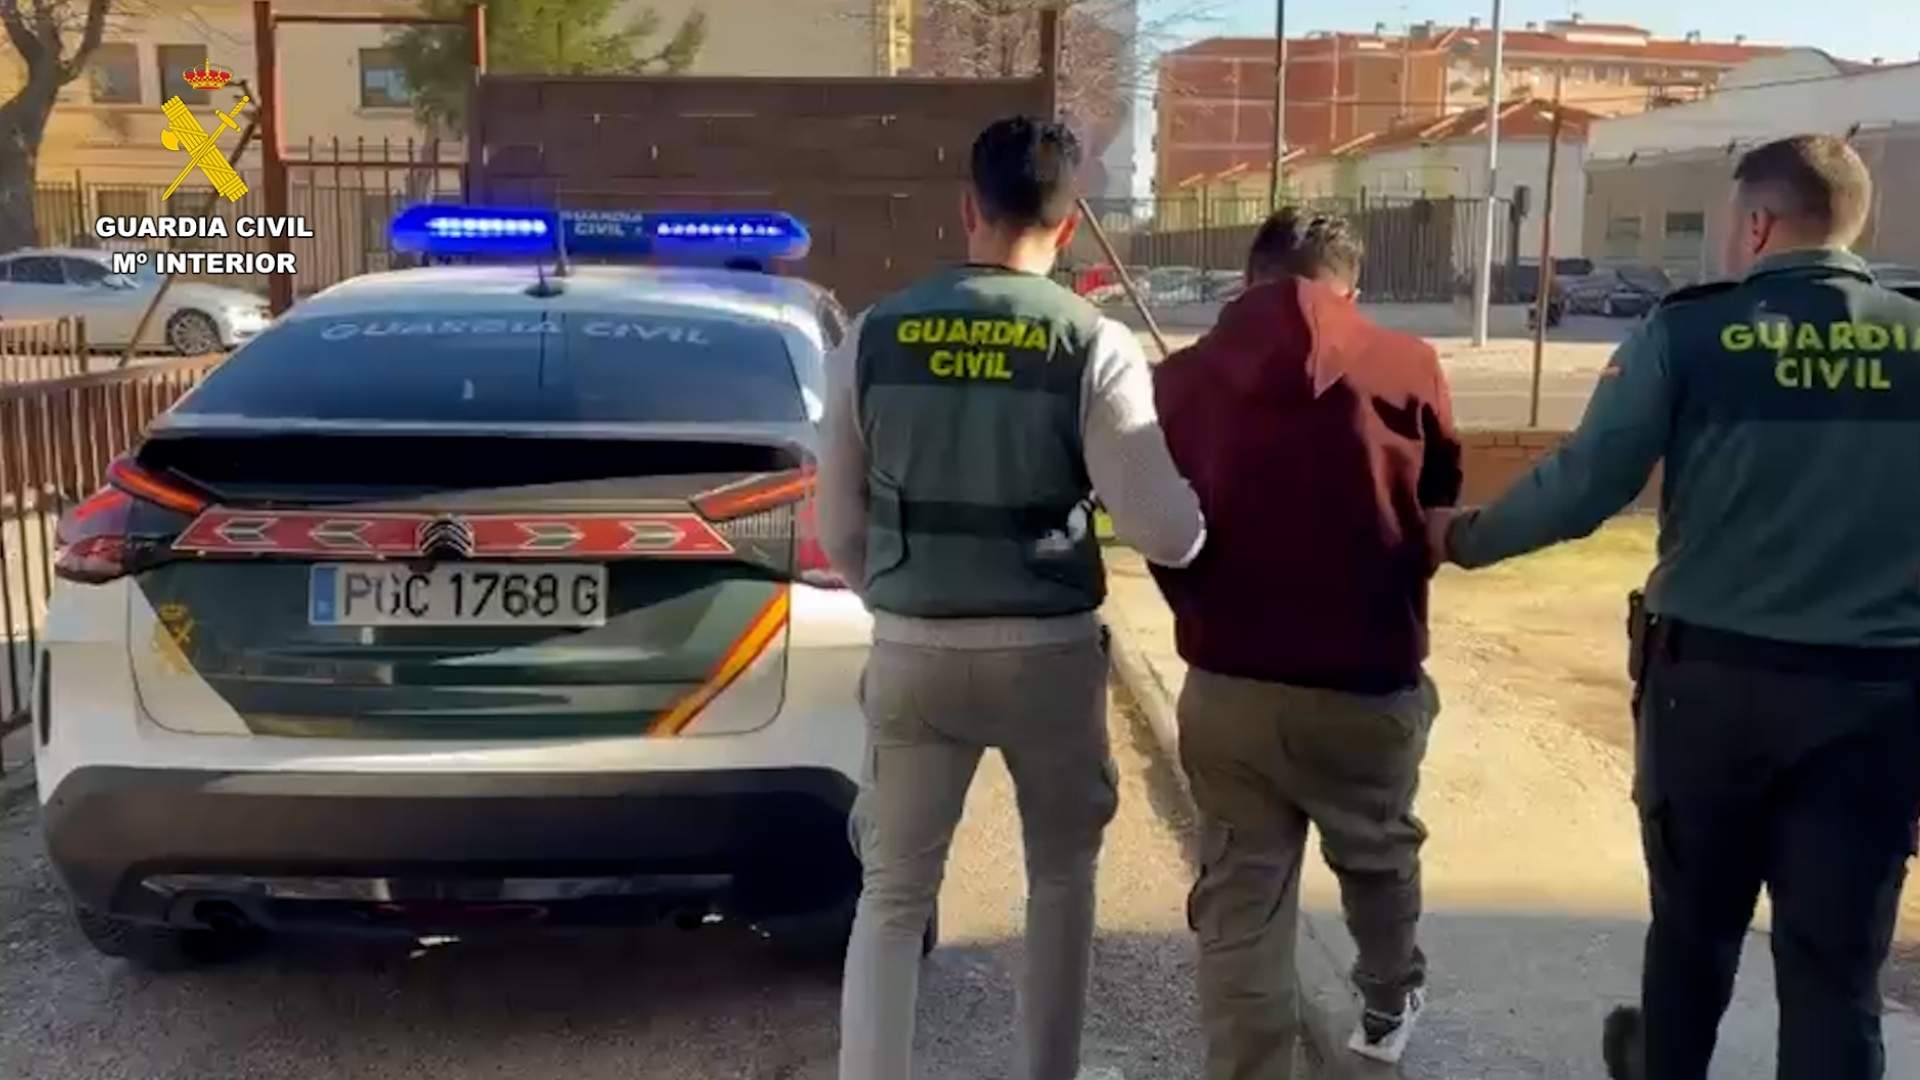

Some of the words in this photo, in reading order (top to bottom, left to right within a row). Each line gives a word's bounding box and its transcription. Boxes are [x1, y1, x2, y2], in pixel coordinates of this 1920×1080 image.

[574, 222, 625, 236] CIVIL
[320, 320, 561, 340] GUARDIA
[583, 321, 710, 345] CIVIL
[897, 318, 1048, 350] GUARDIA
[930, 350, 1013, 379] CIVIL
[1775, 356, 1892, 390] CIVIL
[344, 572, 430, 617] PGC
[450, 573, 559, 618] 1768
[572, 574, 600, 616] G
